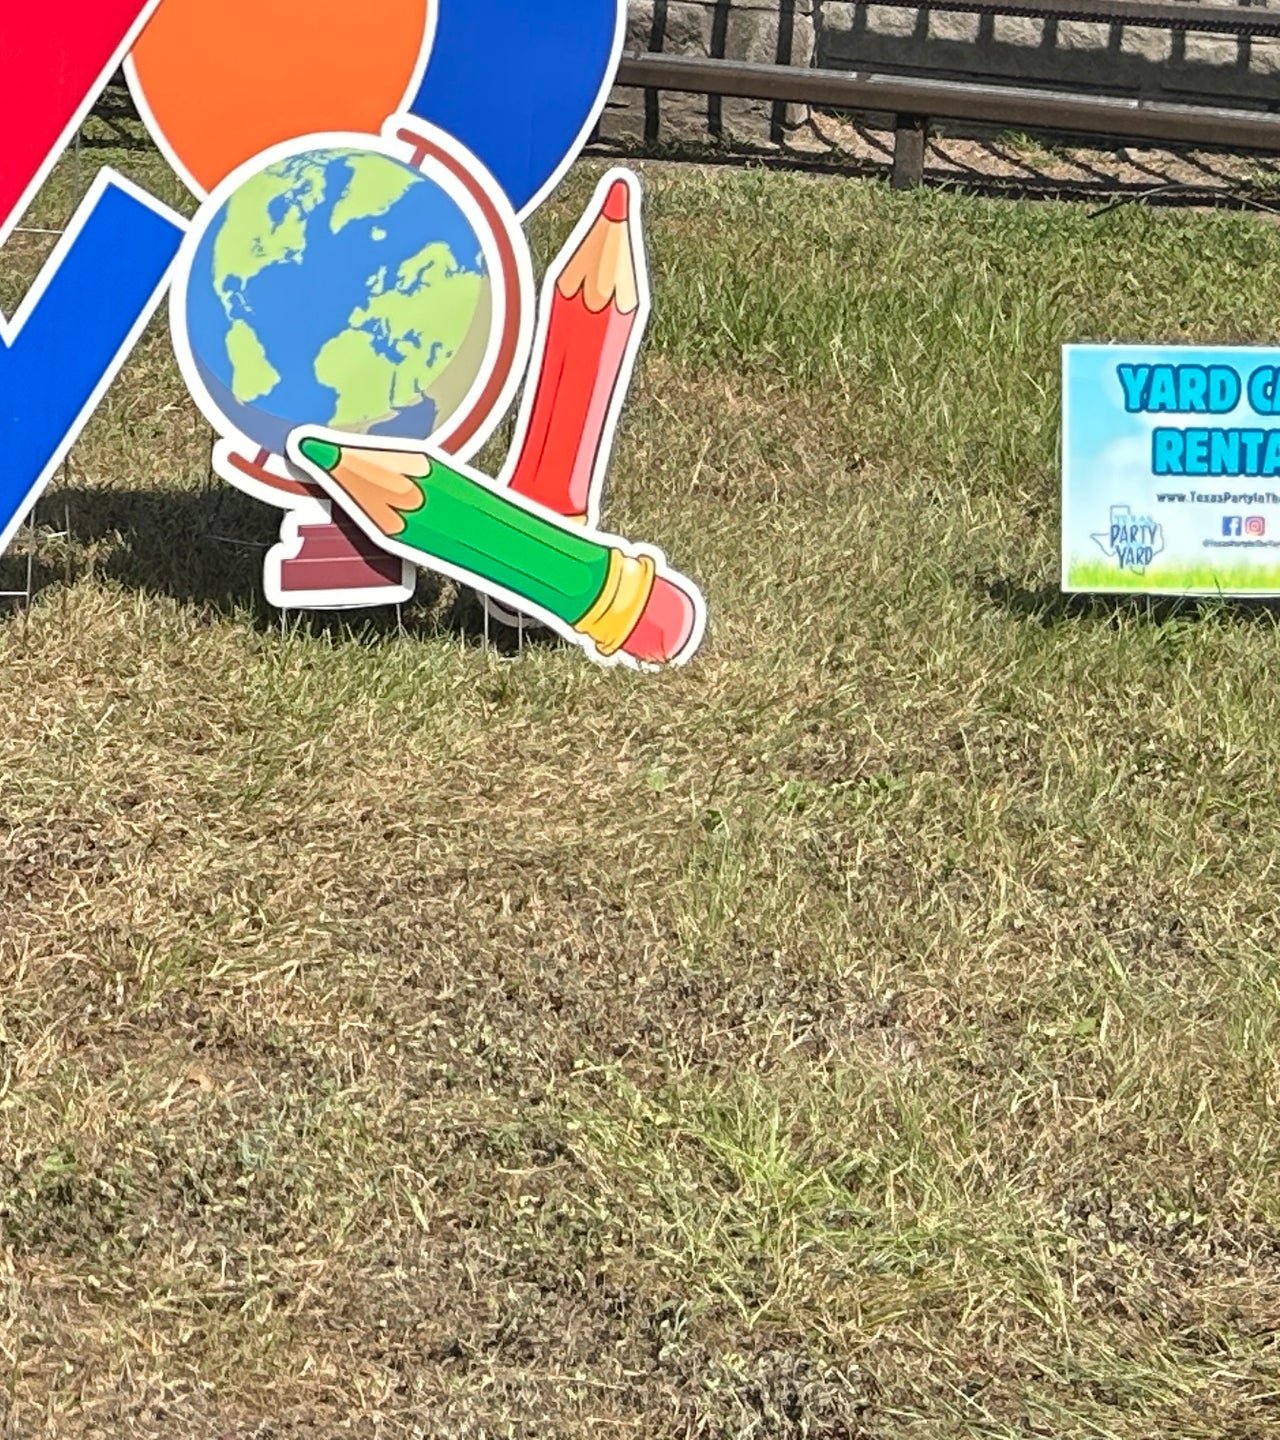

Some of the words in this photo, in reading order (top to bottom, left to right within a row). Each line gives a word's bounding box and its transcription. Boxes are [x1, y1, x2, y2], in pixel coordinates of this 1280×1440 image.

[1117, 363, 1242, 414] YARD
[1247, 364, 1280, 416] C
[1110, 524, 1158, 548] PARTY
[1115, 545, 1153, 570] YARD
